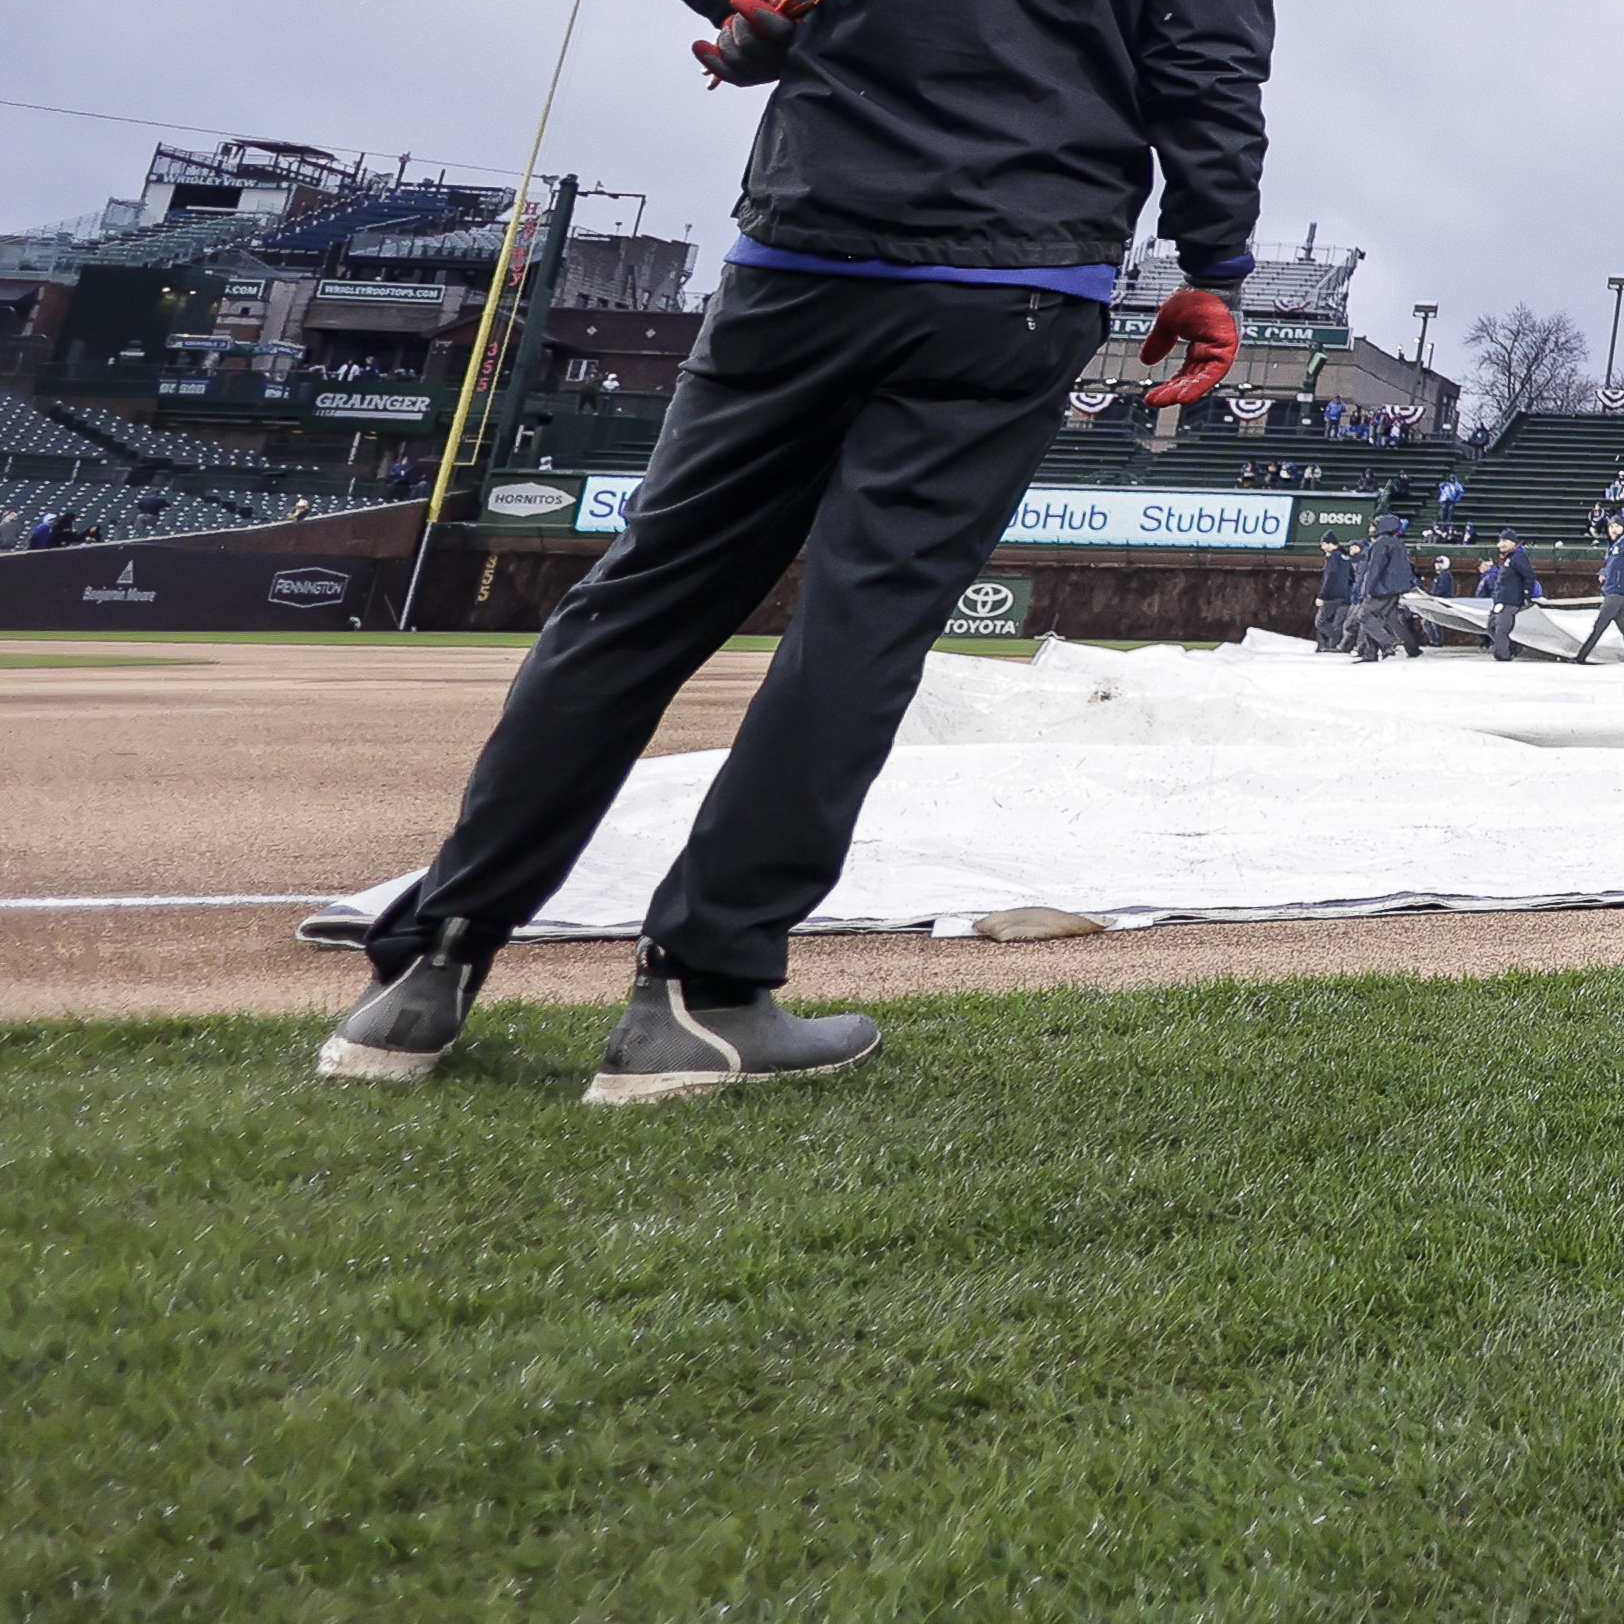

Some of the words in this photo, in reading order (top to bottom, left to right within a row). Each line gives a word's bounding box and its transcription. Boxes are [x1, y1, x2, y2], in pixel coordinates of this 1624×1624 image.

[316, 393, 430, 411] GRAINGER
[494, 493, 563, 505] HORNITOS
[1139, 505, 1281, 536] StubHub
[1319, 512, 1362, 526] BOSCH
[274, 579, 342, 595] PENNINGTON
[944, 619, 1016, 635] TOYOTA
